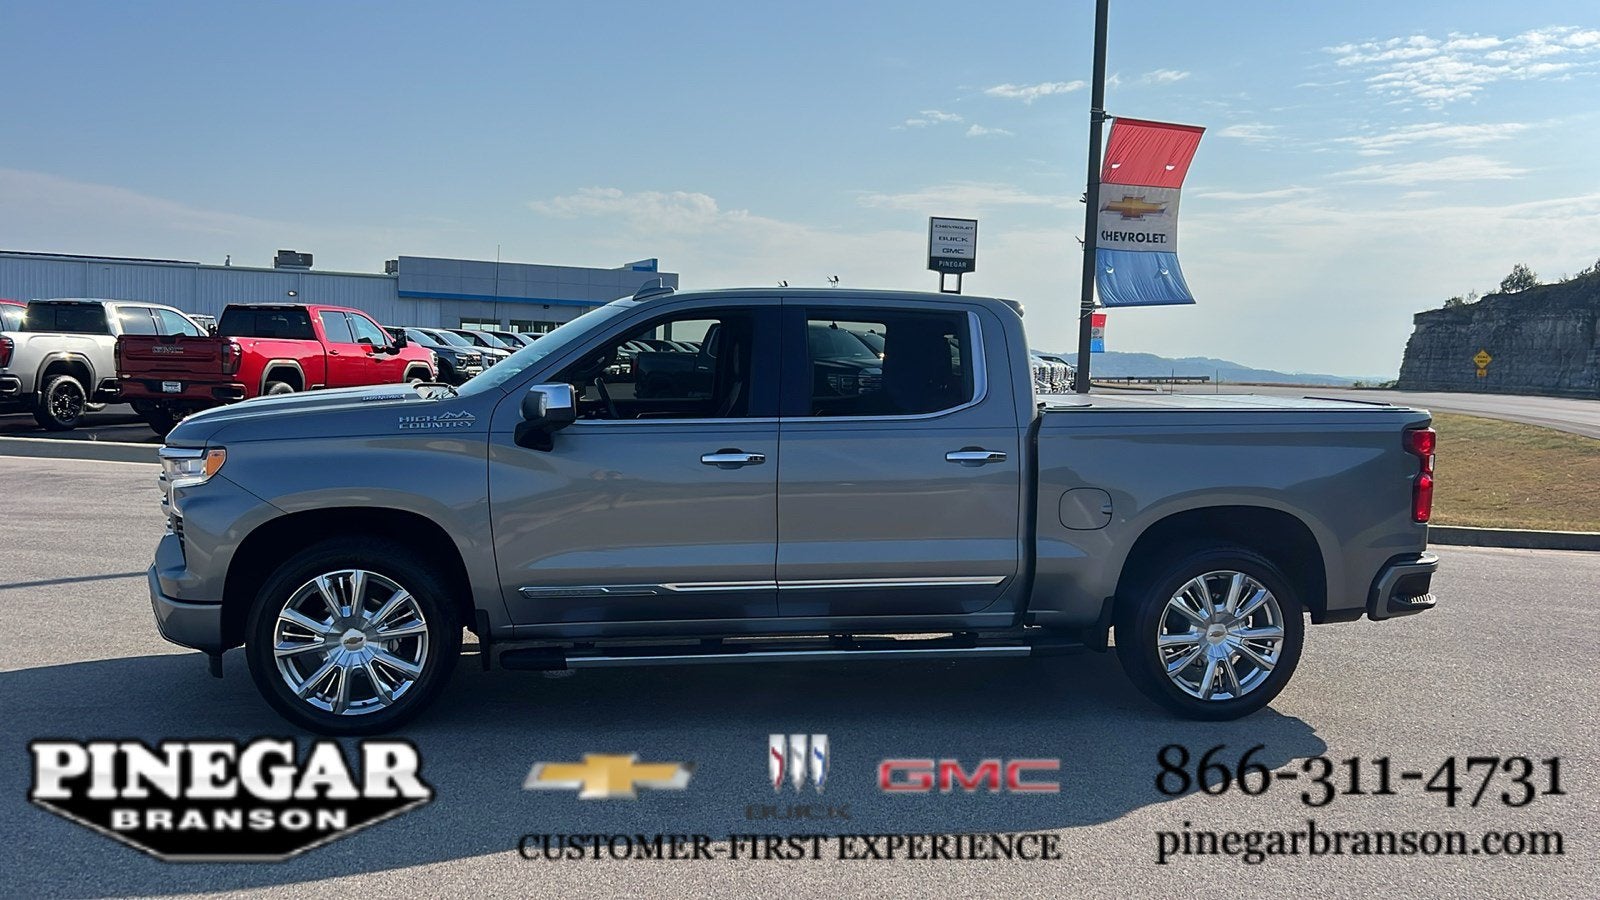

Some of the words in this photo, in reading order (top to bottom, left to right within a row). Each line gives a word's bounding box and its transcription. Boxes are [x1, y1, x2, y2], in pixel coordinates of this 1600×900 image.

[1101, 230, 1166, 244] CHEVROLET
[938, 260, 967, 268] PINEGAR
[399, 420, 473, 429] COUNTRY
